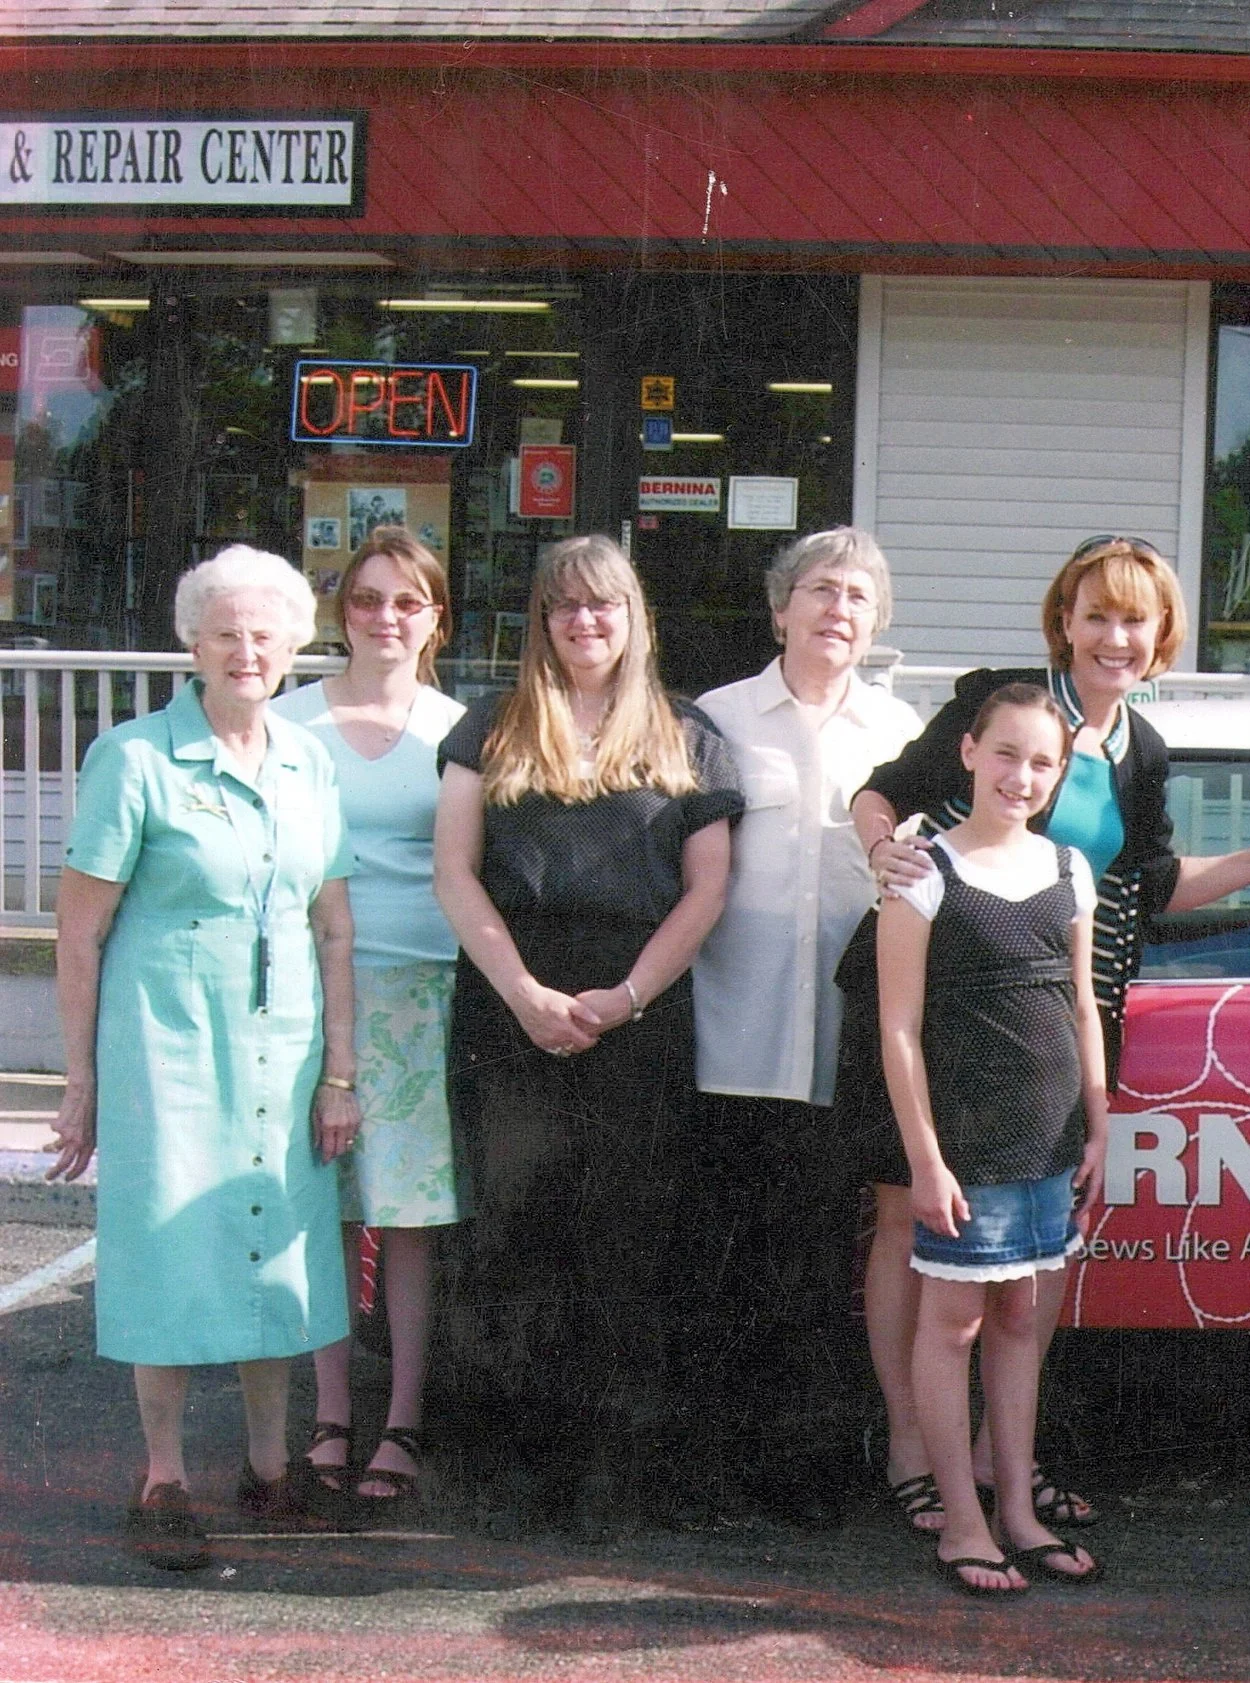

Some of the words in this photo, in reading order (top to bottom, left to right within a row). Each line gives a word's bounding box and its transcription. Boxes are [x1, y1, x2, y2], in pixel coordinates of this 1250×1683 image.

[10, 129, 32, 182] &
[53, 128, 184, 185] REPAIR
[200, 127, 349, 185] CENTER
[300, 368, 469, 436] OPEN
[639, 481, 716, 495] BERNINA
[1165, 1231, 1230, 1261] Like
